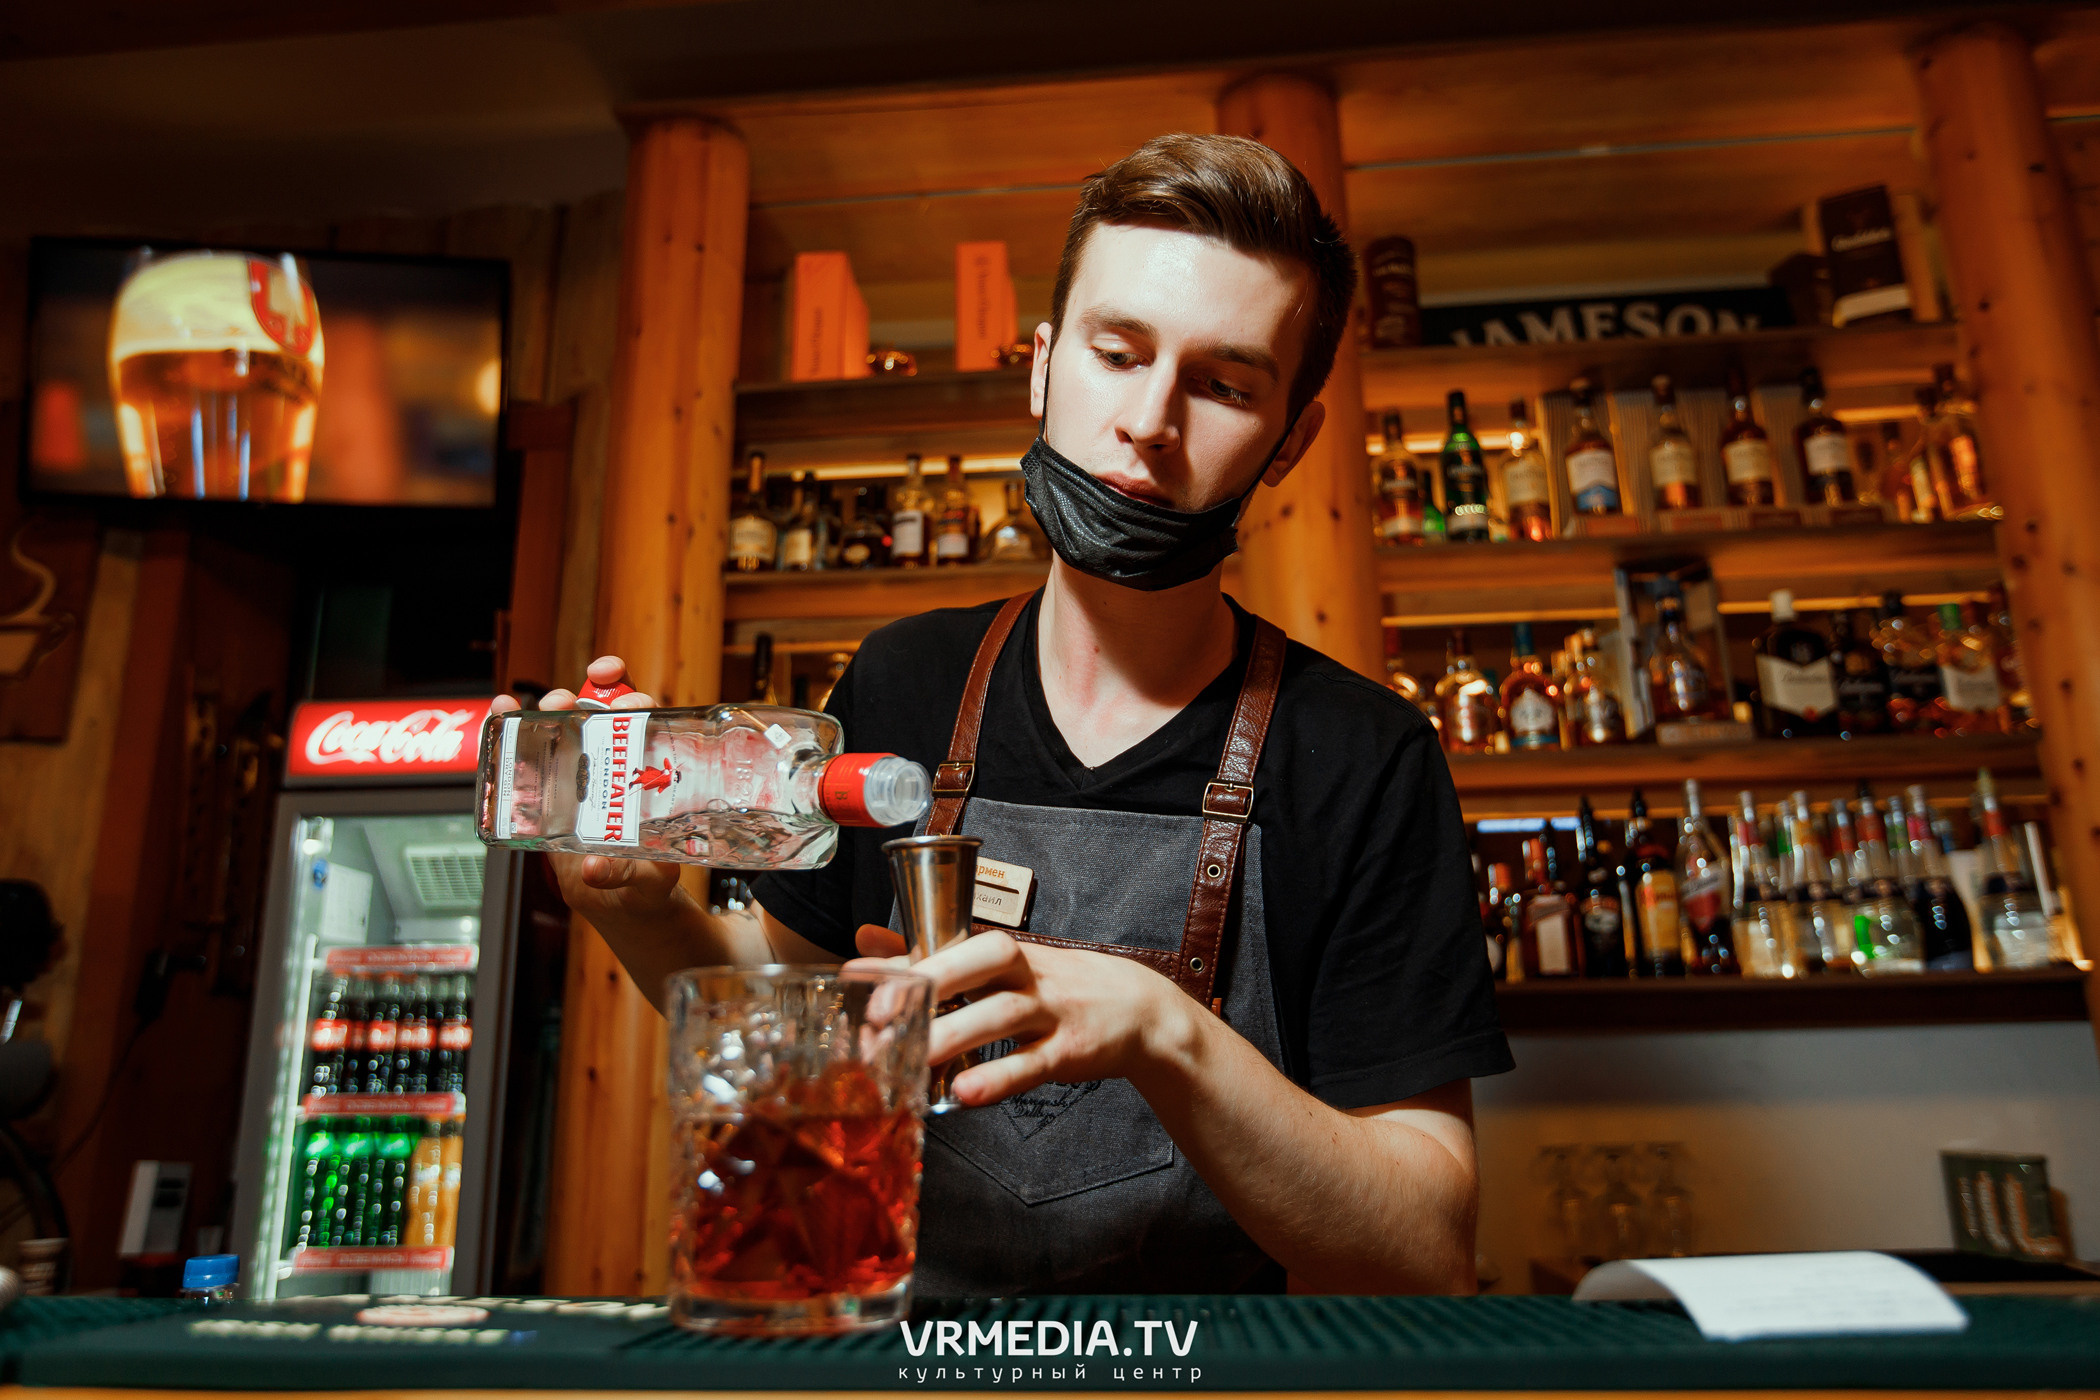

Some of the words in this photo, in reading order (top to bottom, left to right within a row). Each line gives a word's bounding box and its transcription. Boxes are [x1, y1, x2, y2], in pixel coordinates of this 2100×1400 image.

[601, 747, 610, 810] LONDON
[604, 716, 632, 842] BEEFEATER
[975, 864, 1005, 879] рмен
[973, 892, 1003, 906] хаил
